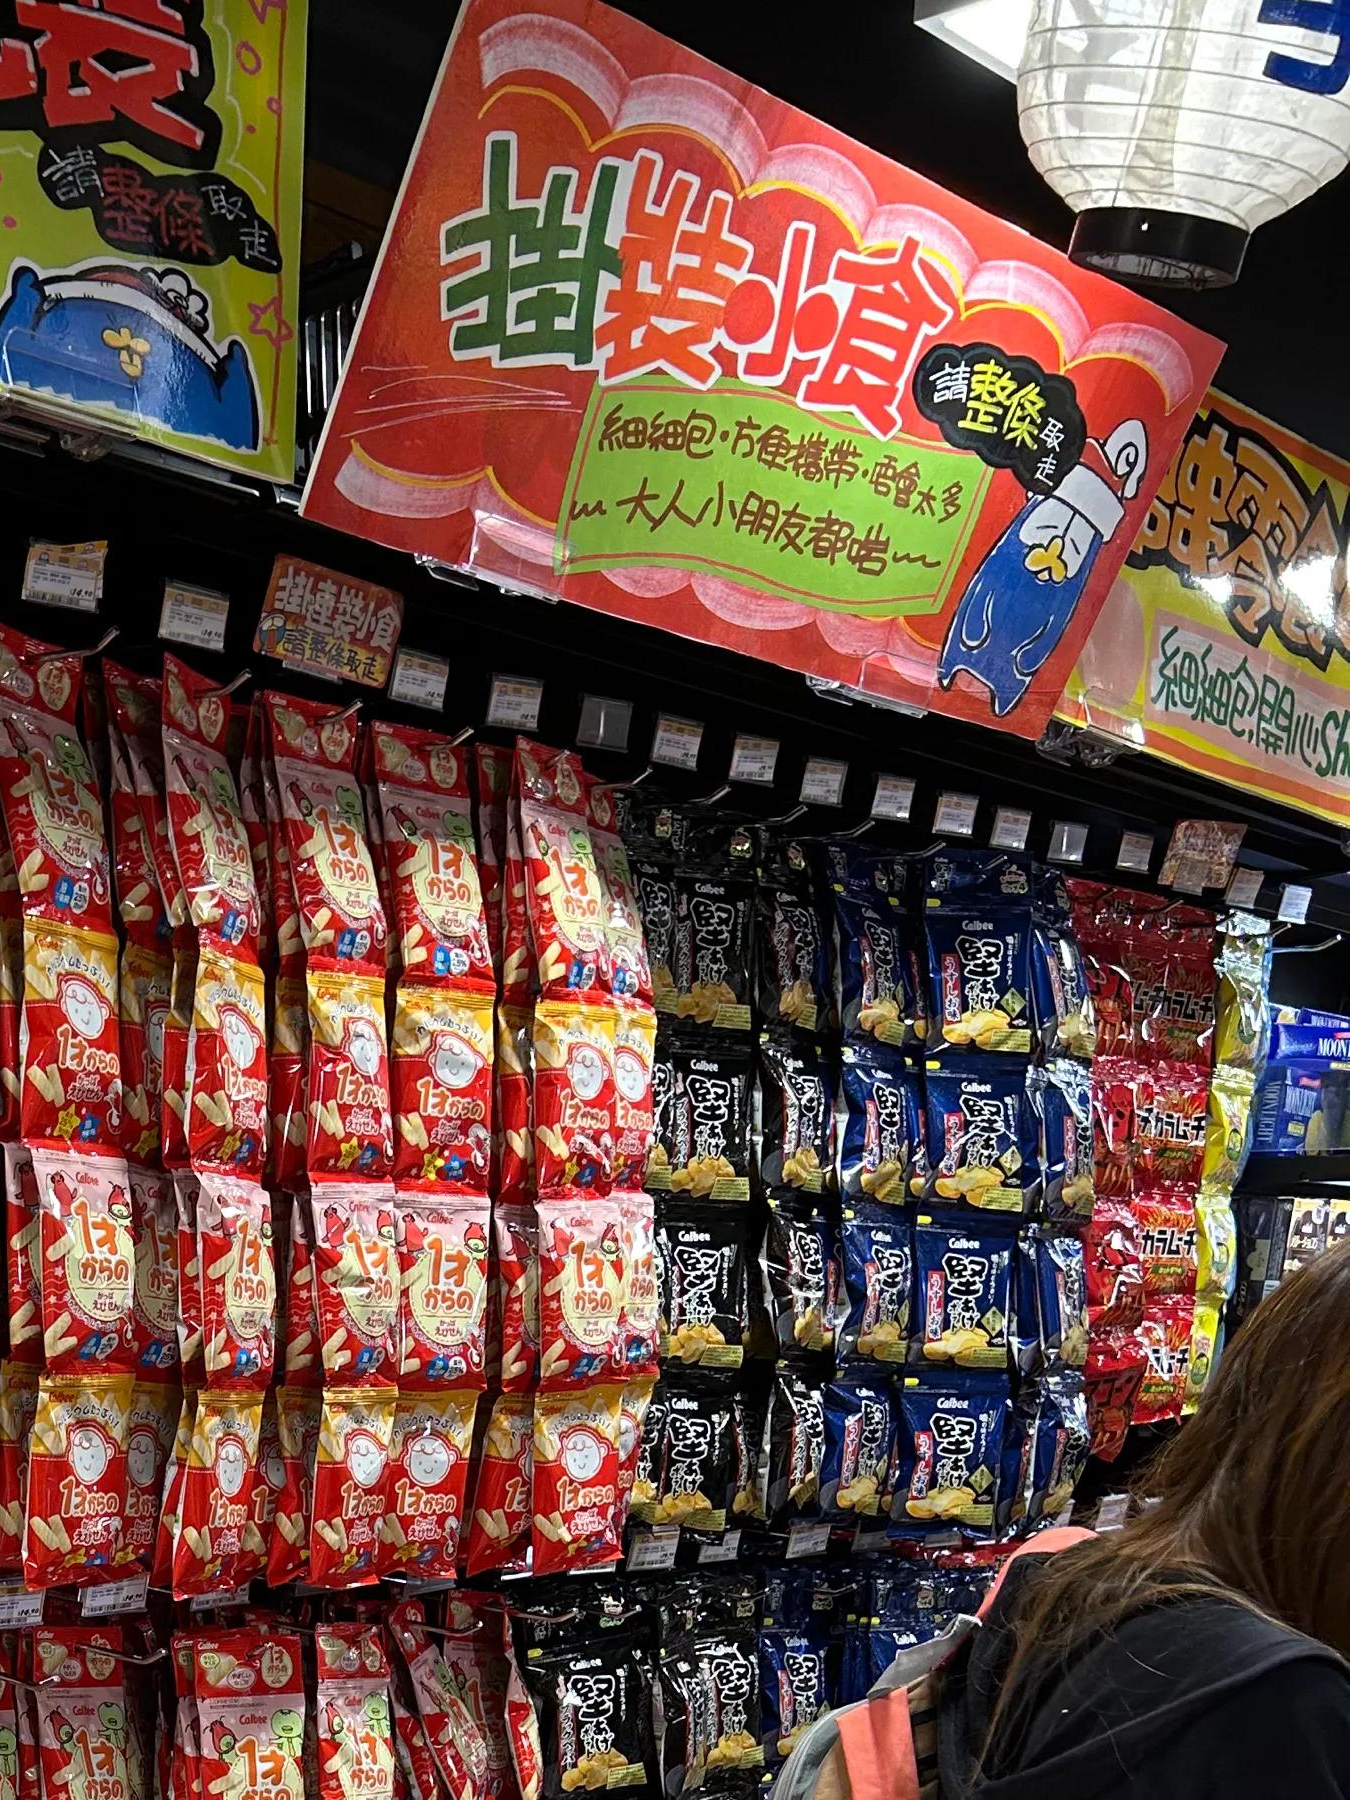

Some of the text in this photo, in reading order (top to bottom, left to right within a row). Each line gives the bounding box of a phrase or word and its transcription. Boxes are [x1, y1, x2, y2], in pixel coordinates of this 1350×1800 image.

[41, 144, 279, 267] 請整條取走
[929, 359, 1065, 487] 請整條取走
[678, 1231, 710, 1242] Calbee
[937, 1398, 968, 1409] Calbee
[570, 1658, 602, 1669] Calbee
